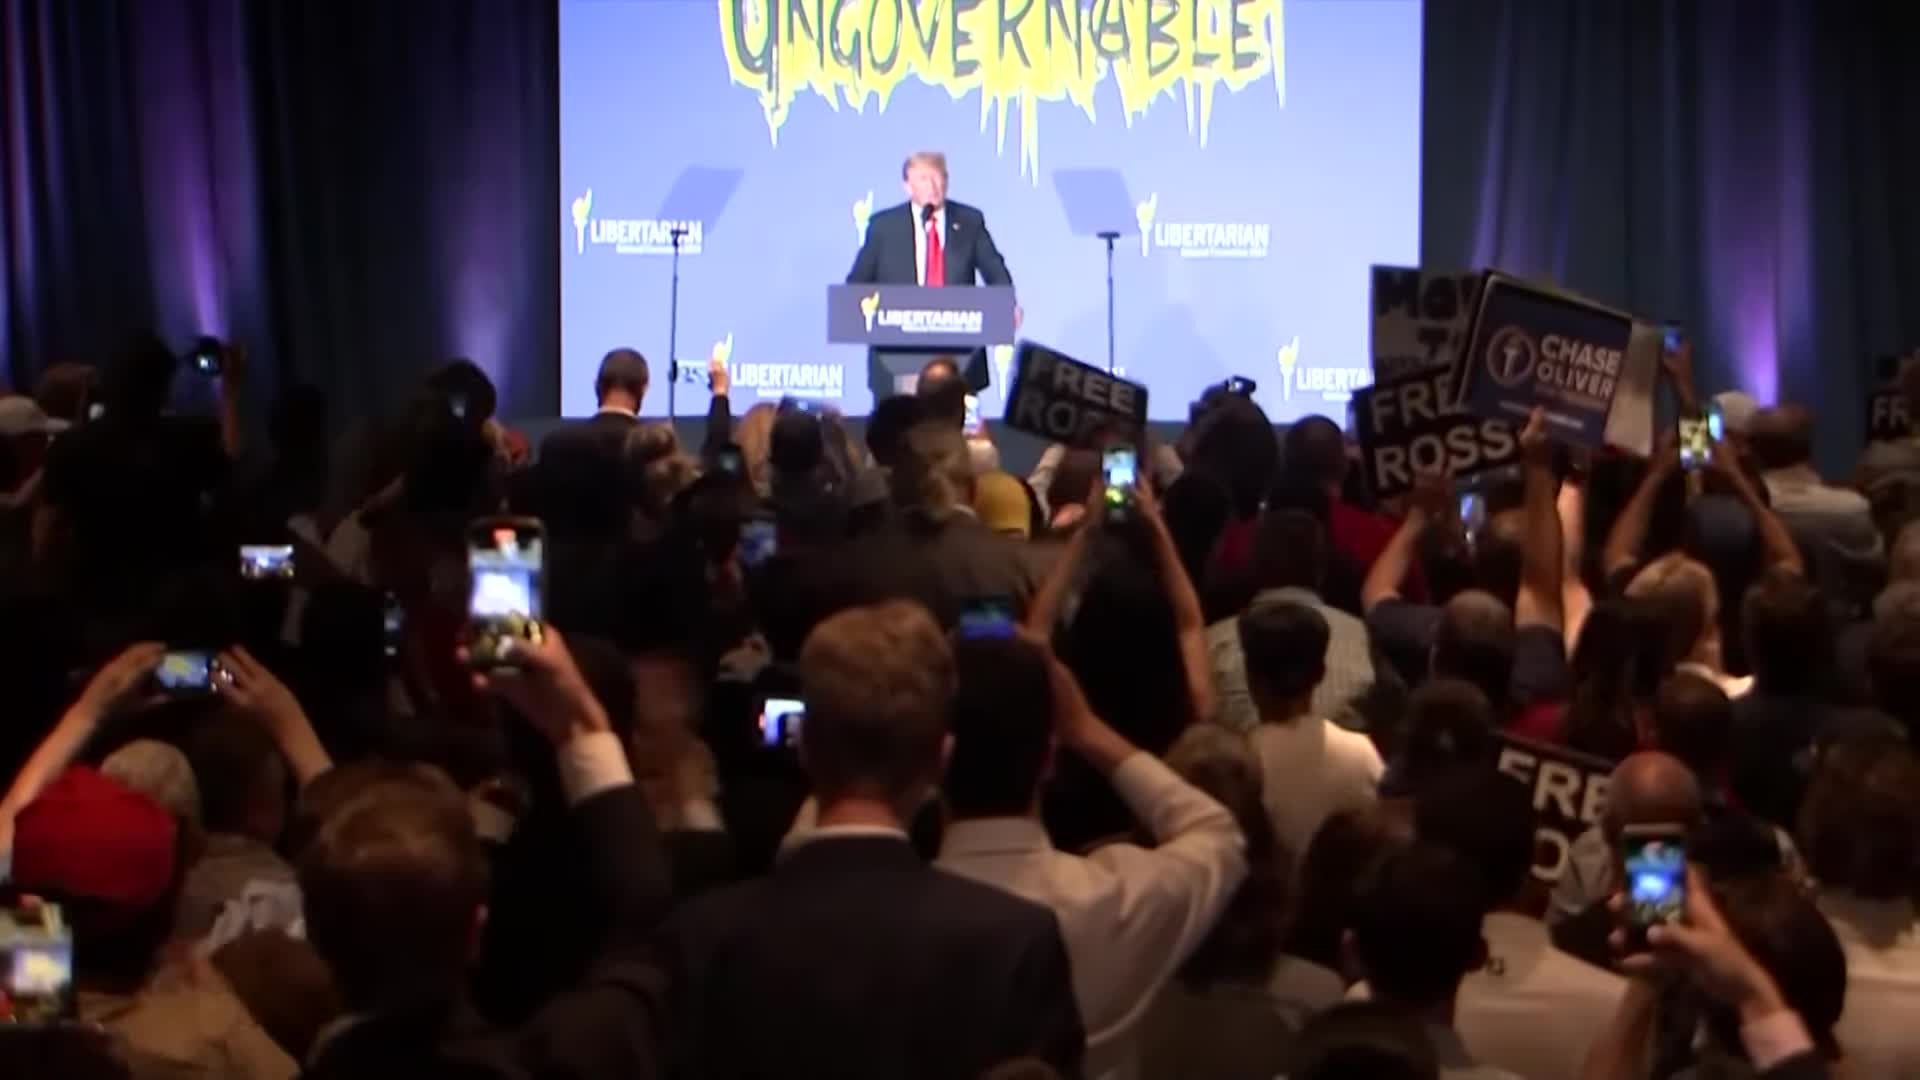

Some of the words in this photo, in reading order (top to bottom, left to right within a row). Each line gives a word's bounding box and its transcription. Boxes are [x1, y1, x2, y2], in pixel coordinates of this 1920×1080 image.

[731, 0, 1265, 104] UNGOVERNABLE
[1155, 223, 1269, 247] LIBERTARIAN
[879, 310, 981, 328] LIBERTARIAN
[732, 363, 842, 386] LIBERTARIAN
[1541, 335, 1621, 376] CHASE
[1027, 350, 1136, 415] FREE
[1296, 368, 1373, 390] LIBERTA
[1536, 361, 1616, 399] OLIVER
[1371, 374, 1462, 433] FRE
[1375, 418, 1515, 489] ROSS
[1497, 746, 1613, 821] FRE
